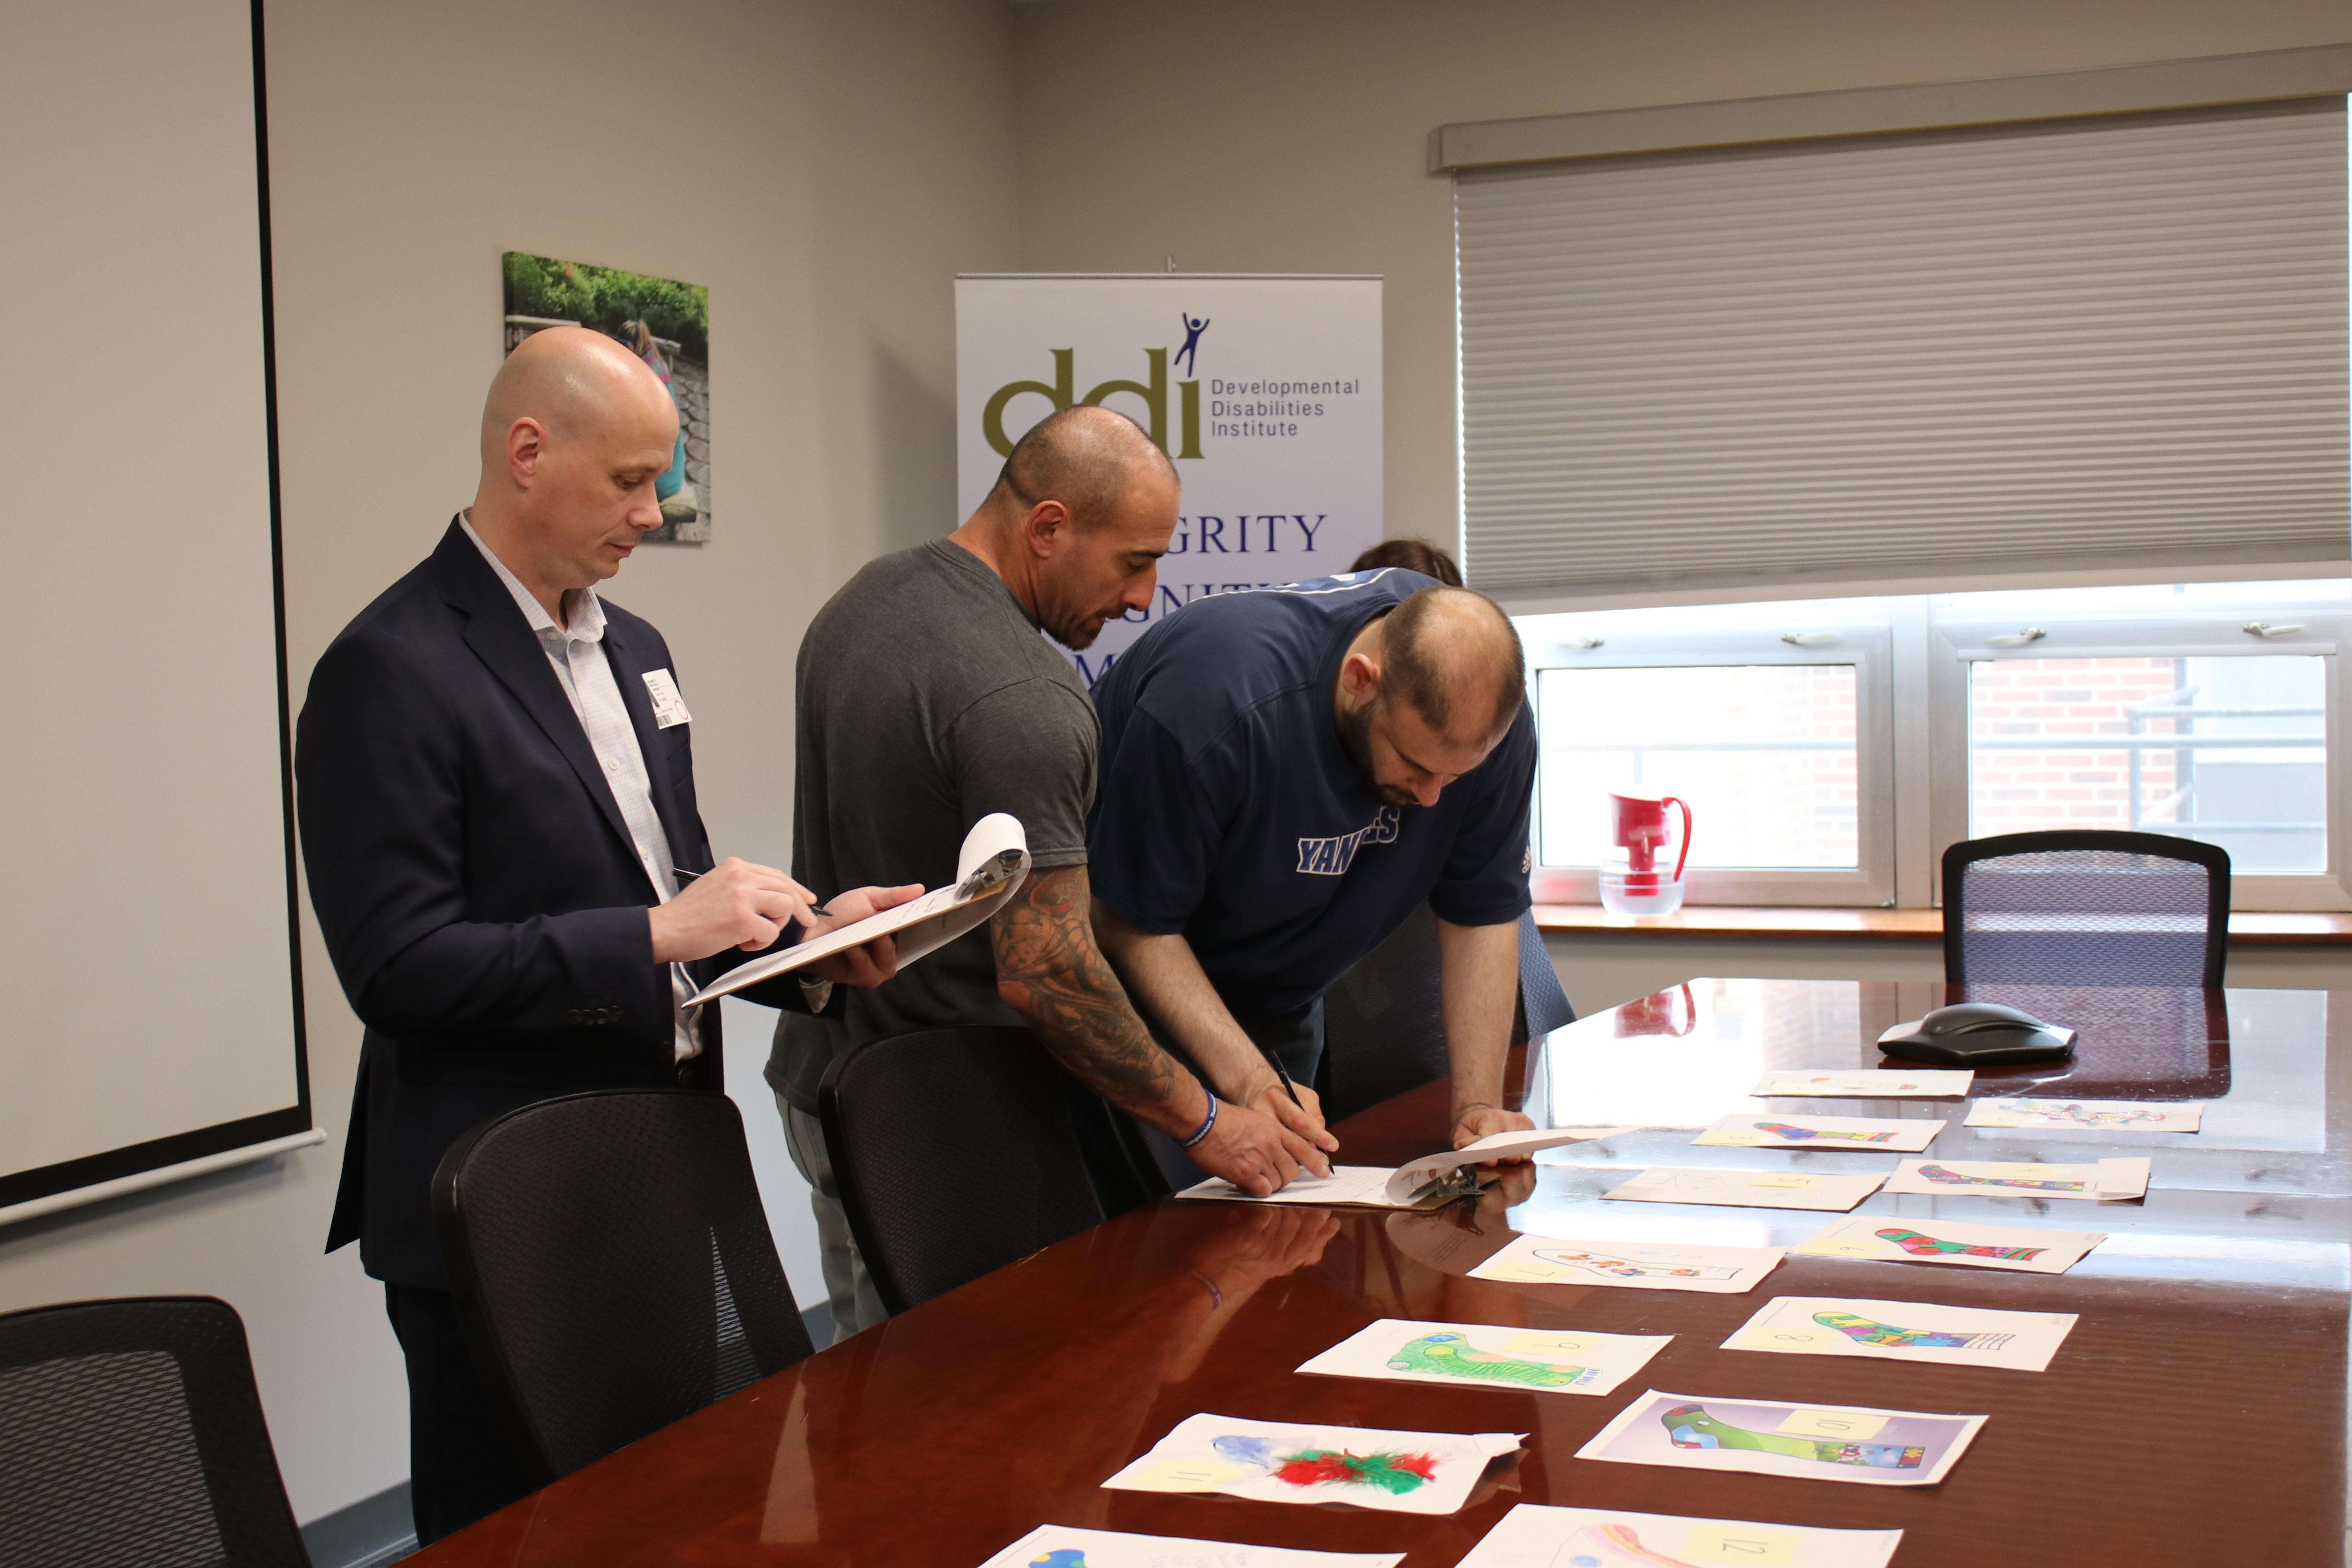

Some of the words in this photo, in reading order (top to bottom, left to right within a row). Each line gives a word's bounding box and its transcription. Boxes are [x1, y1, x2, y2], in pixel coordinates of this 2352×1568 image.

[1212, 379, 1359, 397] Developmental
[982, 346, 1205, 459] ddi
[1212, 400, 1324, 416] Disabilities
[1212, 420, 1298, 436] Institute
[1296, 806, 1400, 875] YANS
[1817, 1419, 1857, 1430] 10
[1722, 1538, 1769, 1553] 12
